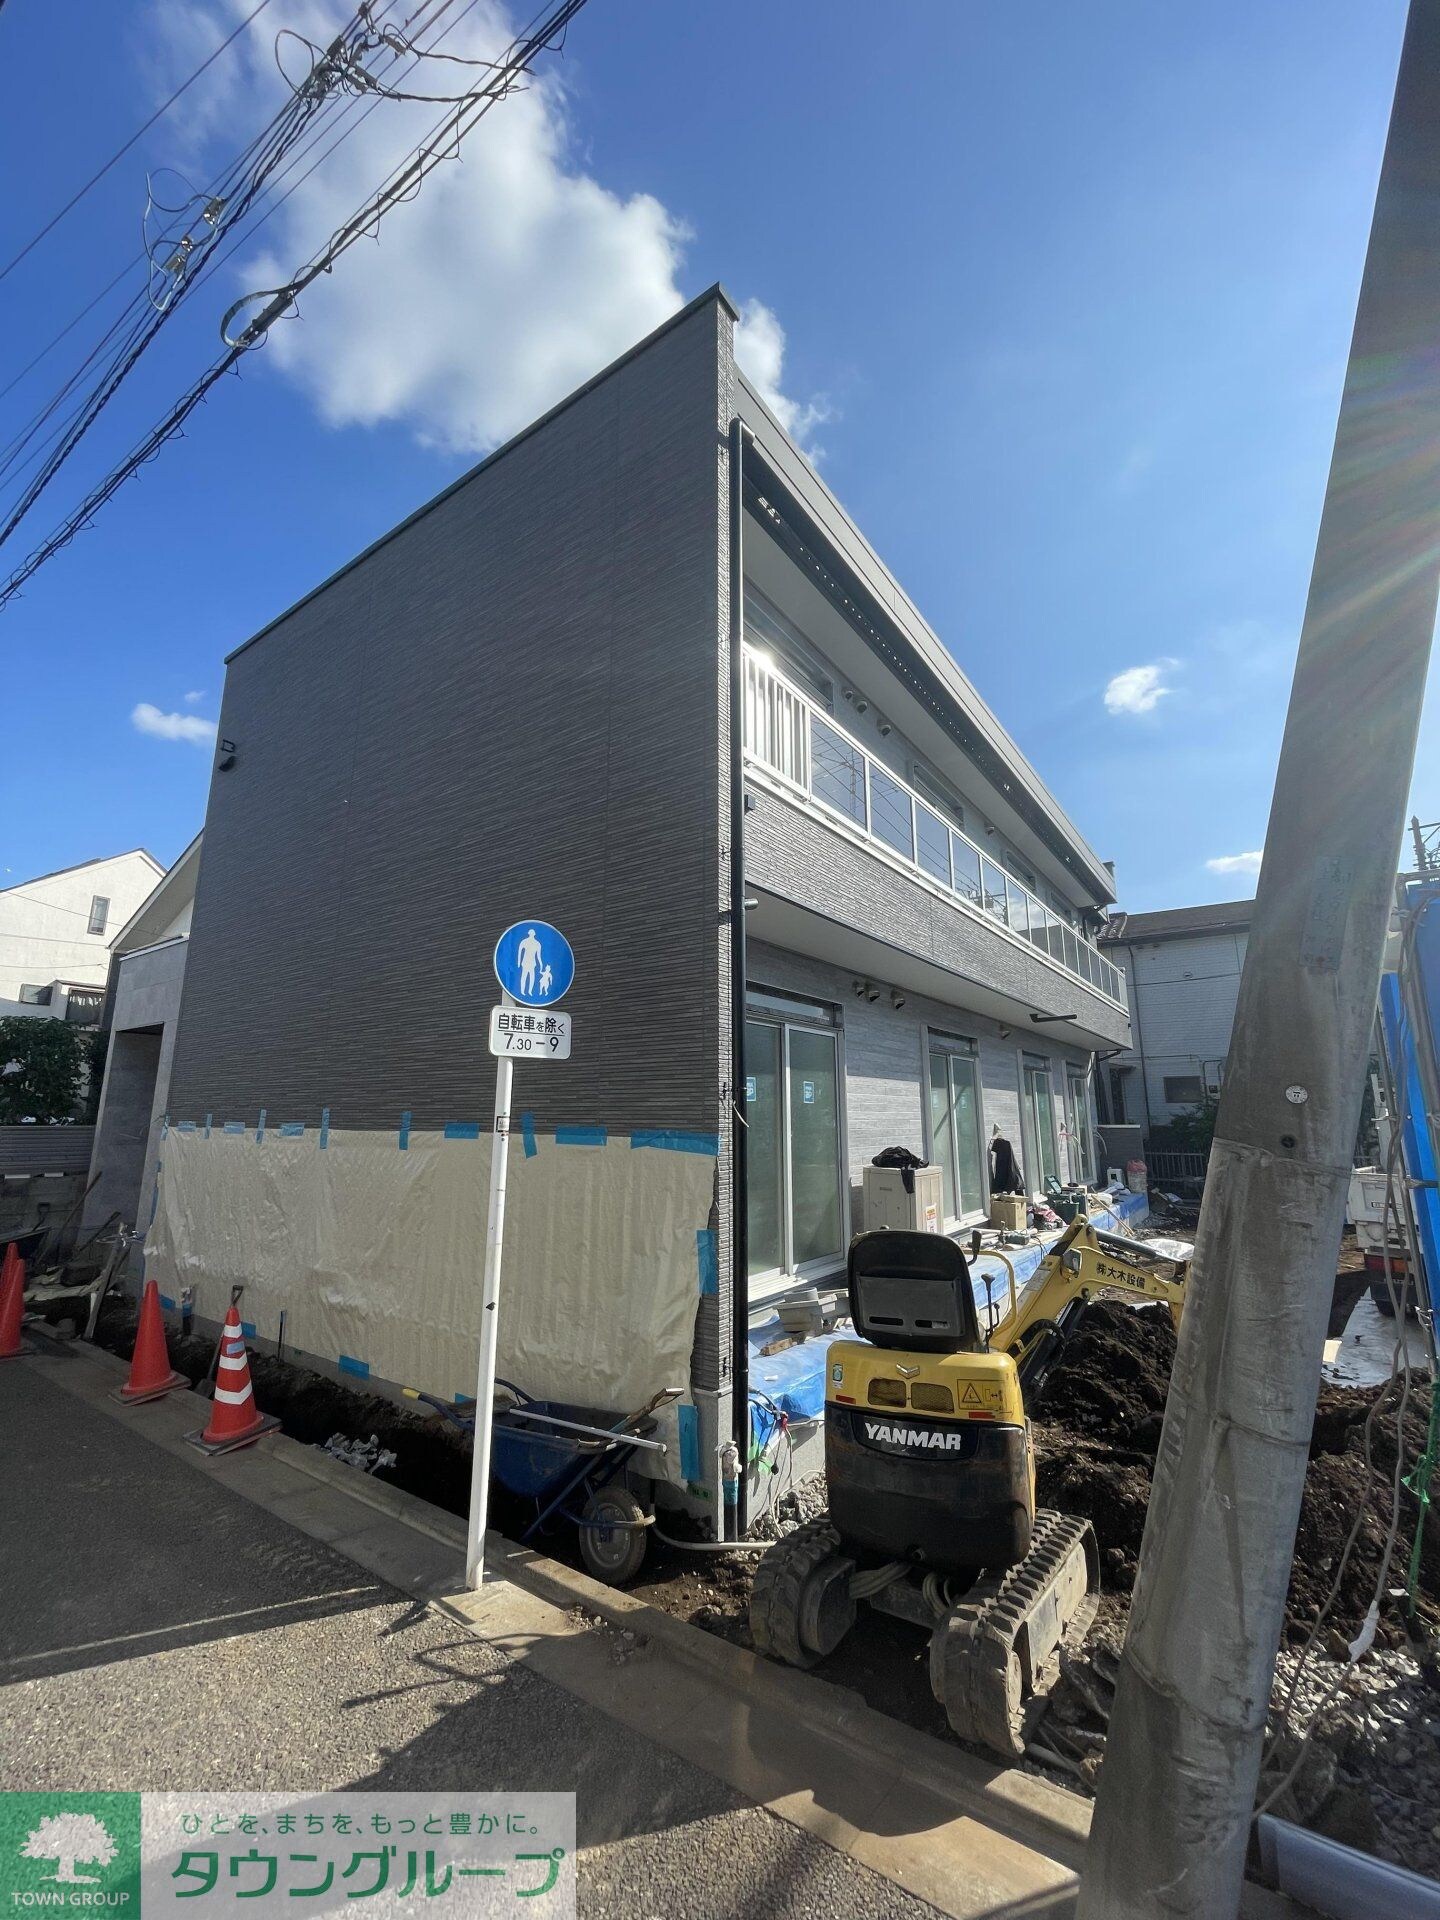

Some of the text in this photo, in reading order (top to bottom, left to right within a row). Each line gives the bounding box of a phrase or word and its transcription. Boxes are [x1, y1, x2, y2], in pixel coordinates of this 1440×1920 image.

[498, 1013, 565, 1034] 自転車を除く
[864, 1422, 962, 1451] YANMAR
